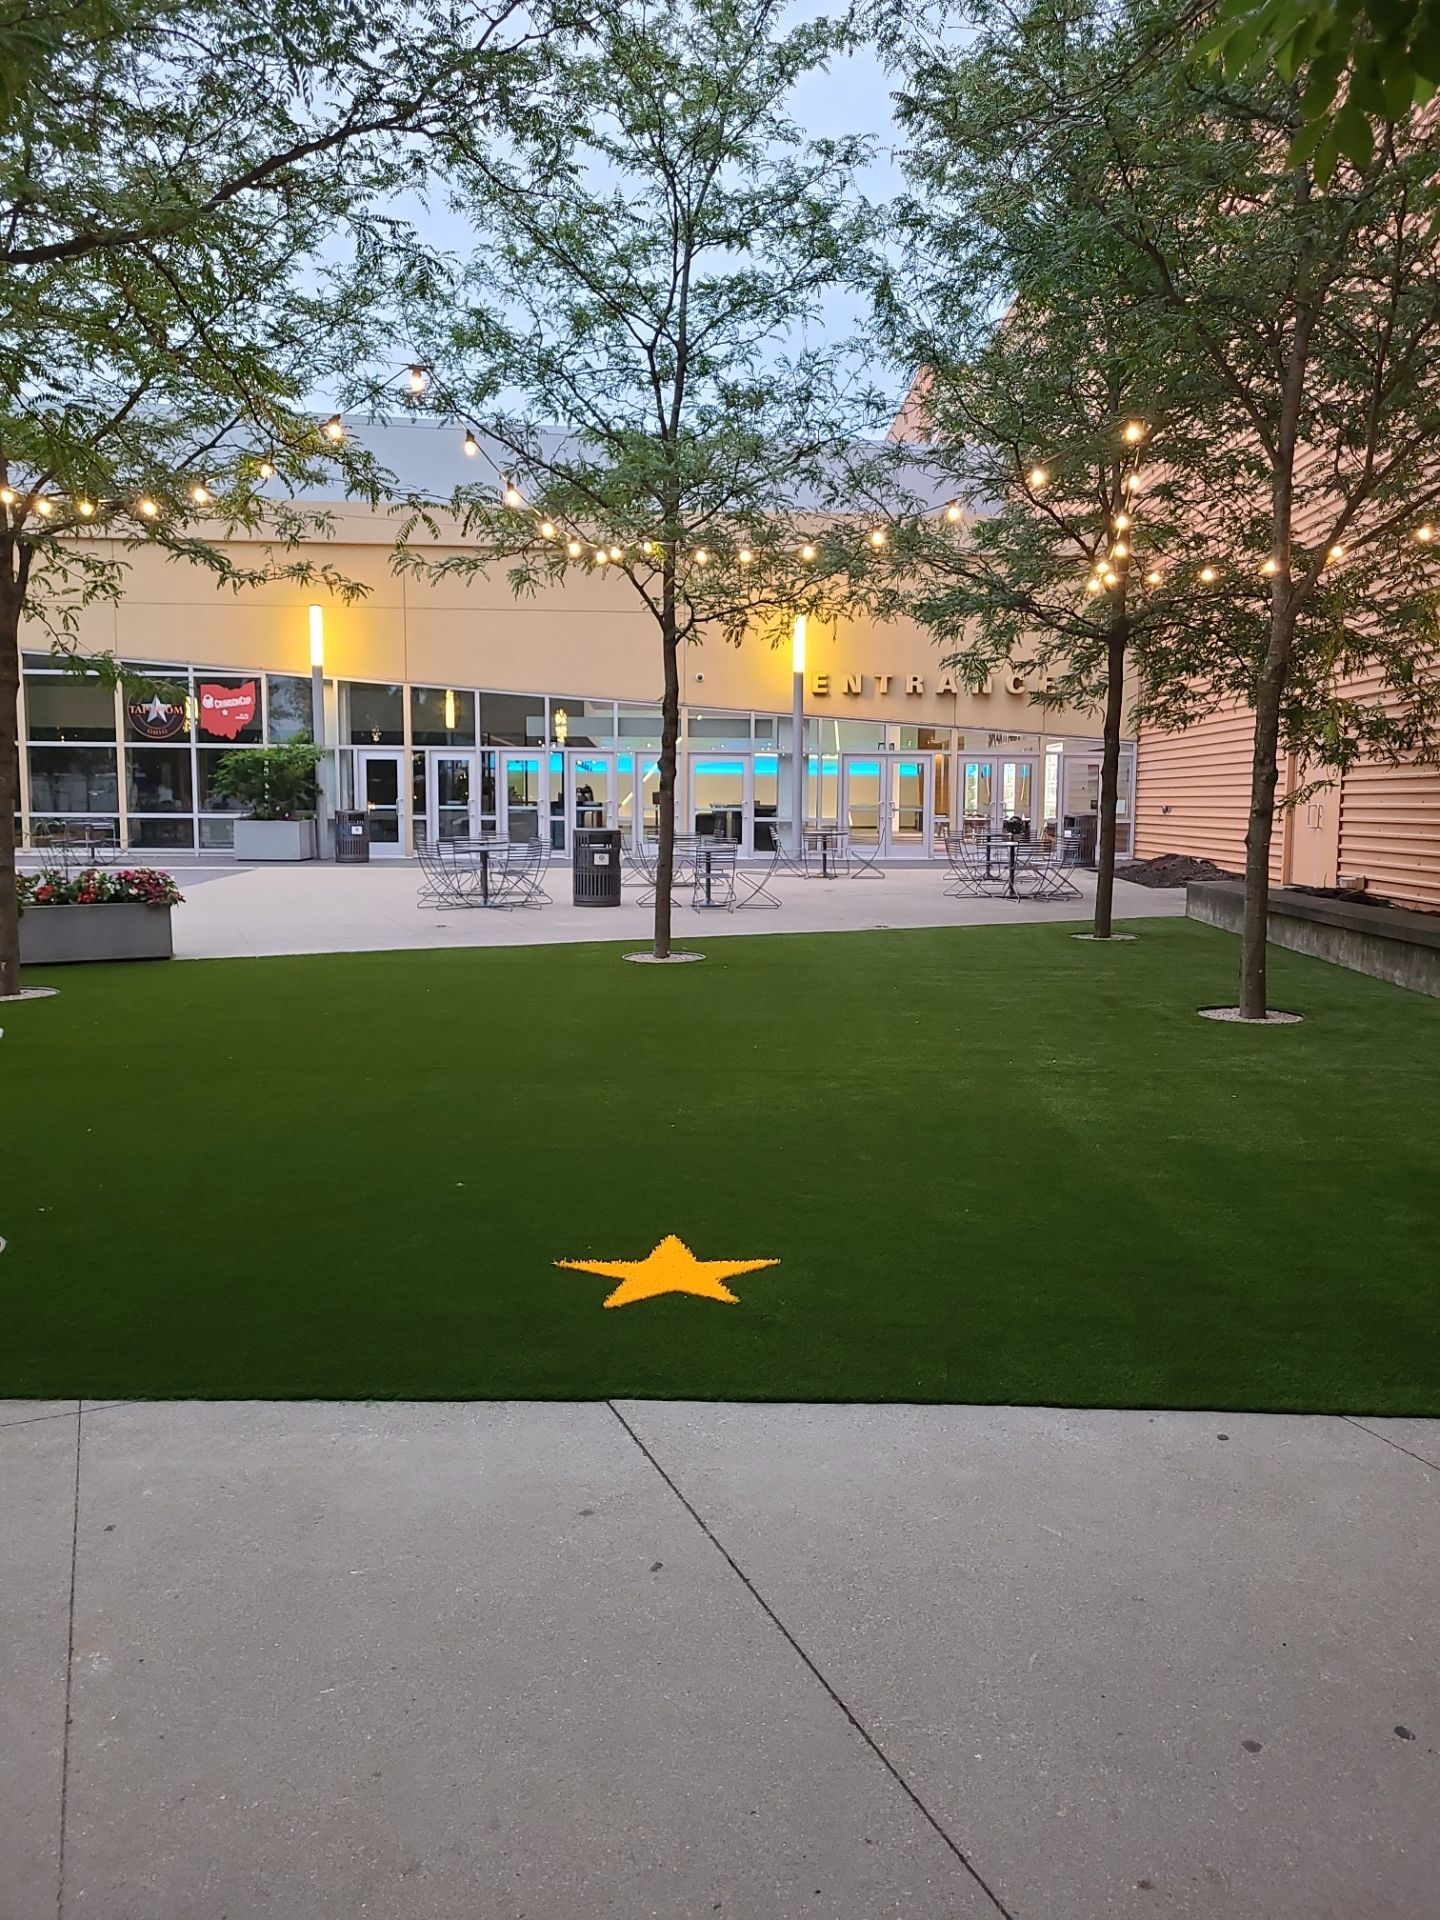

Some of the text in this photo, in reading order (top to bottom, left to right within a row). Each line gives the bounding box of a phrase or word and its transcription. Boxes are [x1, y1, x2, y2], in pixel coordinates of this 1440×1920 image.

[812, 673, 1056, 695] ENTRANCE
[128, 705, 183, 715] TAPOM
[147, 728, 168, 736] OHIO
